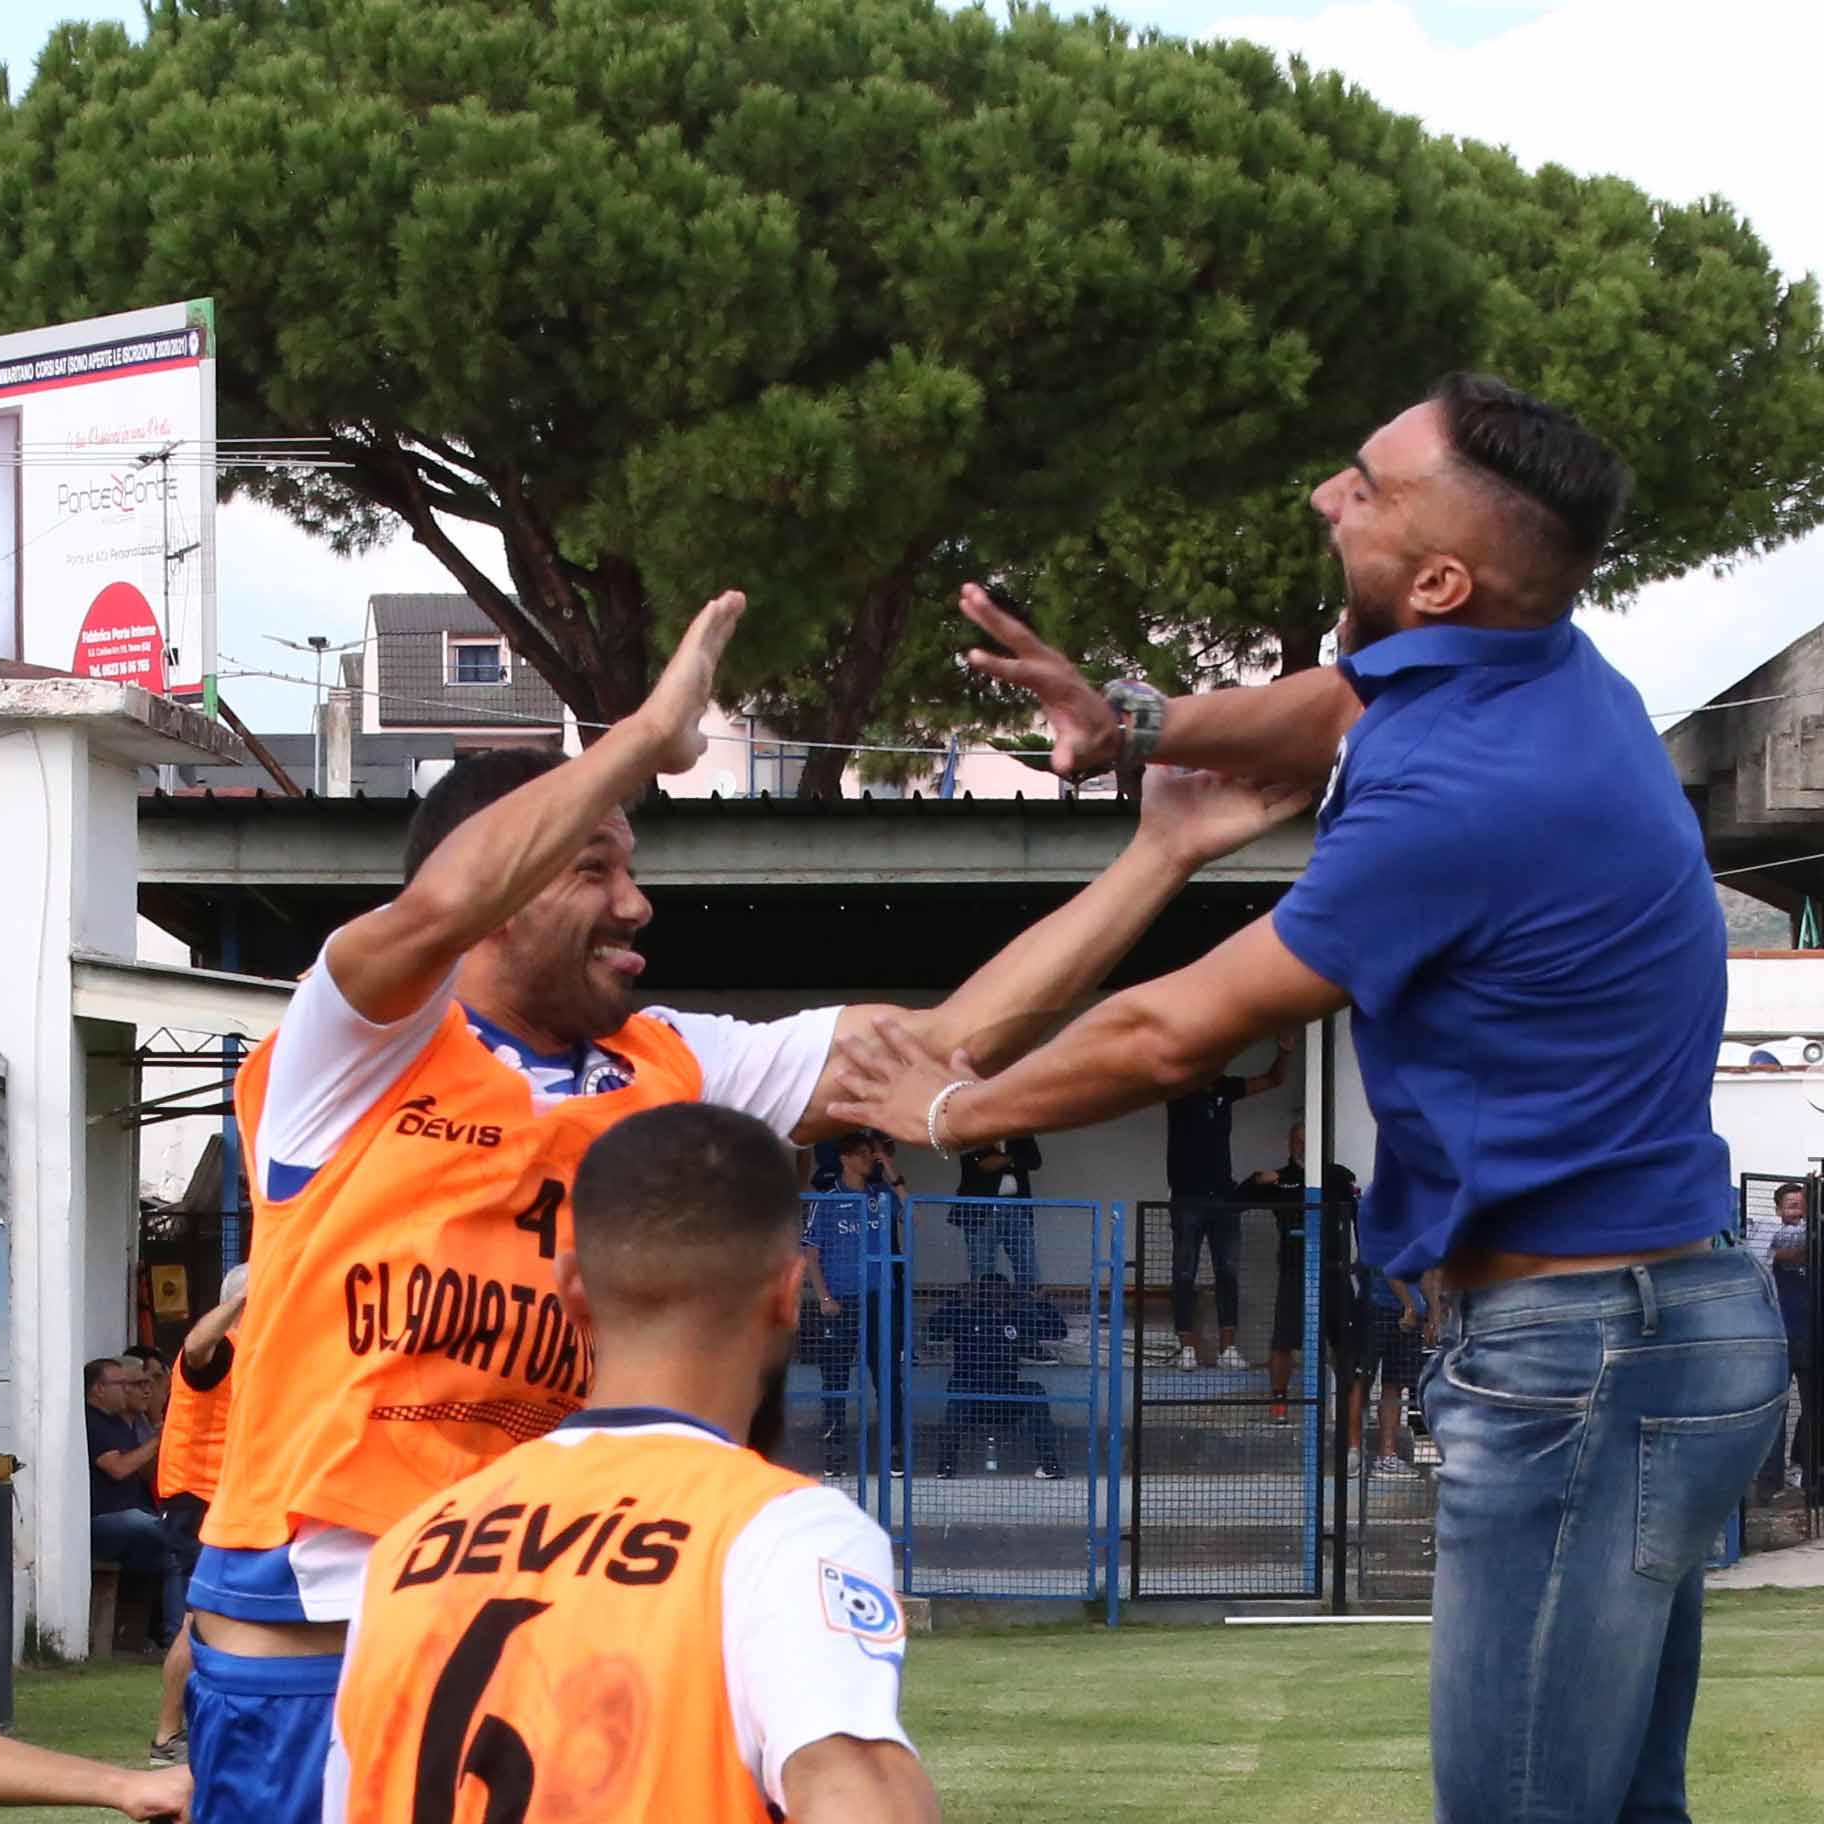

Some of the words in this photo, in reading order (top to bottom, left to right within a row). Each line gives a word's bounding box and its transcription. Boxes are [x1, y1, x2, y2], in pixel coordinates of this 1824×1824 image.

[88, 348, 113, 370] APERTE
[113, 346, 122, 367] LE
[514, 1178, 566, 1260] 4
